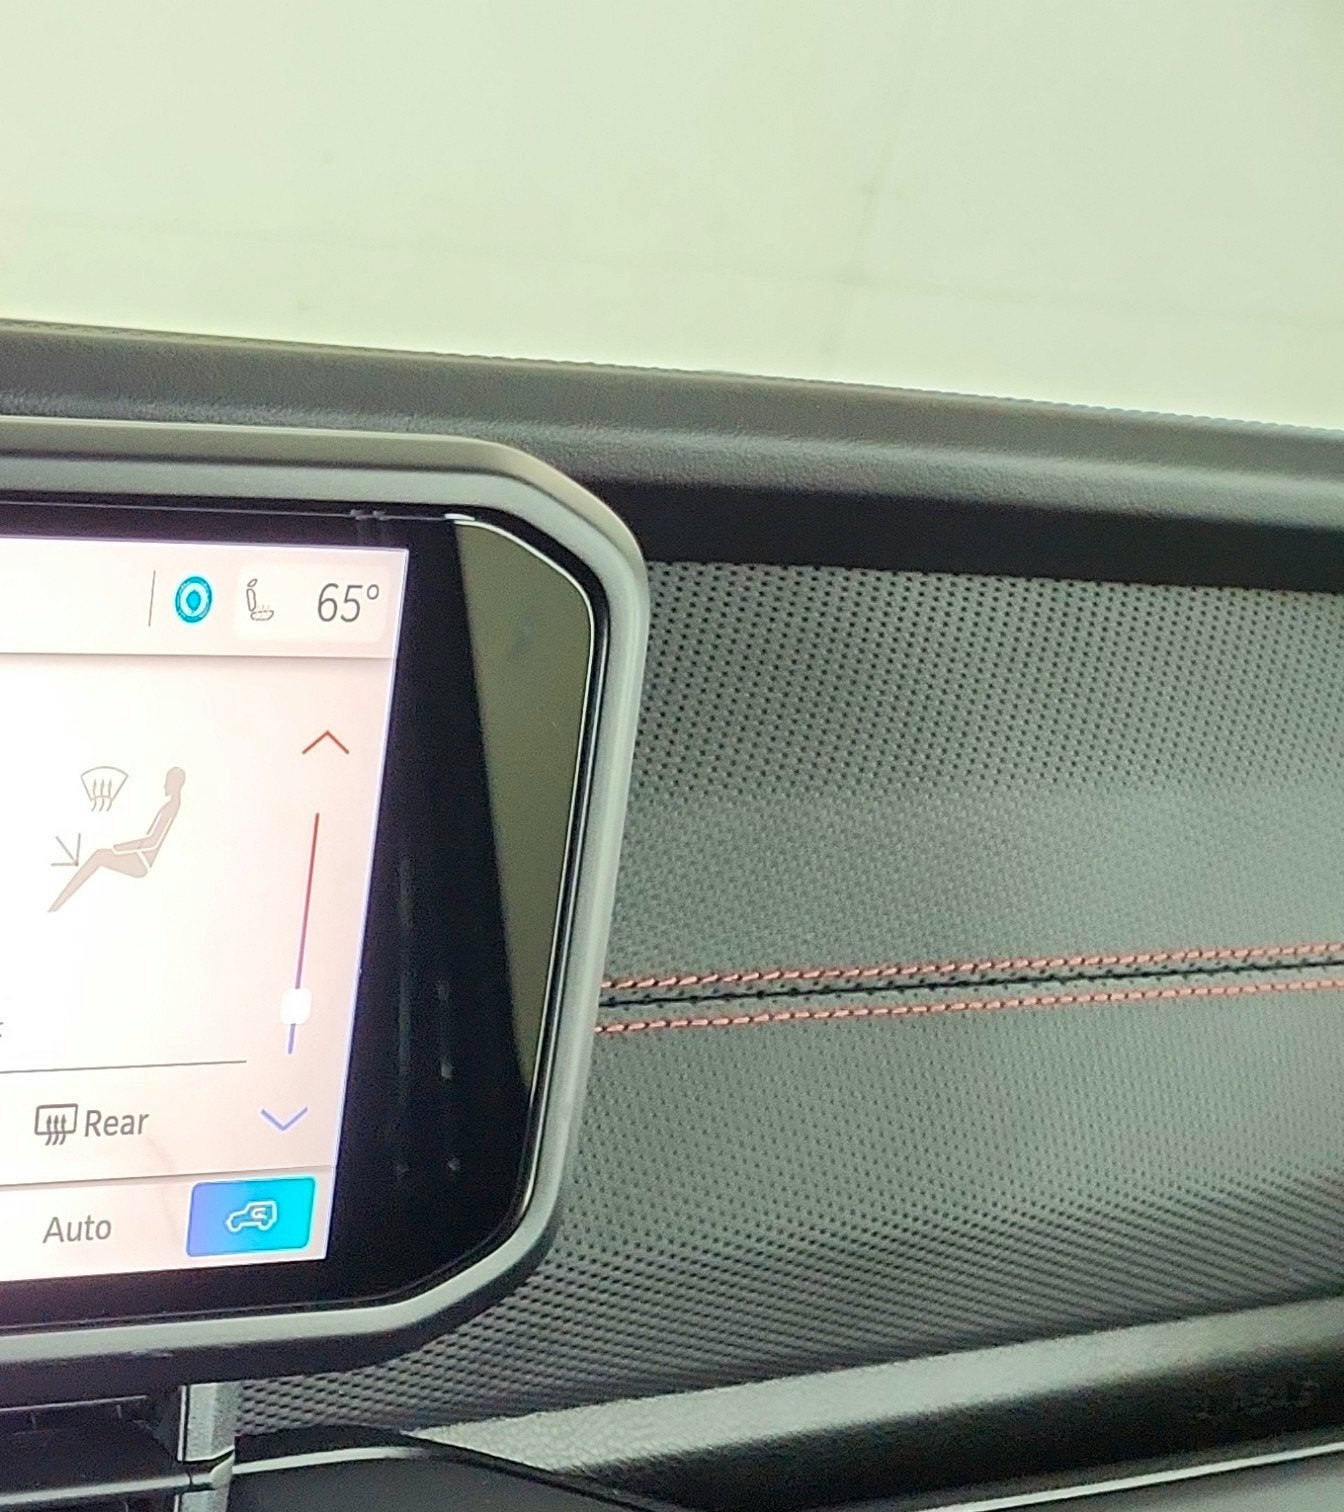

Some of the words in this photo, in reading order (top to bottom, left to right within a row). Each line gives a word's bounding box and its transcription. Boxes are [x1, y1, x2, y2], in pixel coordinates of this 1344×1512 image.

[316, 583, 381, 625] 65°
[84, 1107, 150, 1138] Rear
[42, 1213, 113, 1243] Auto
